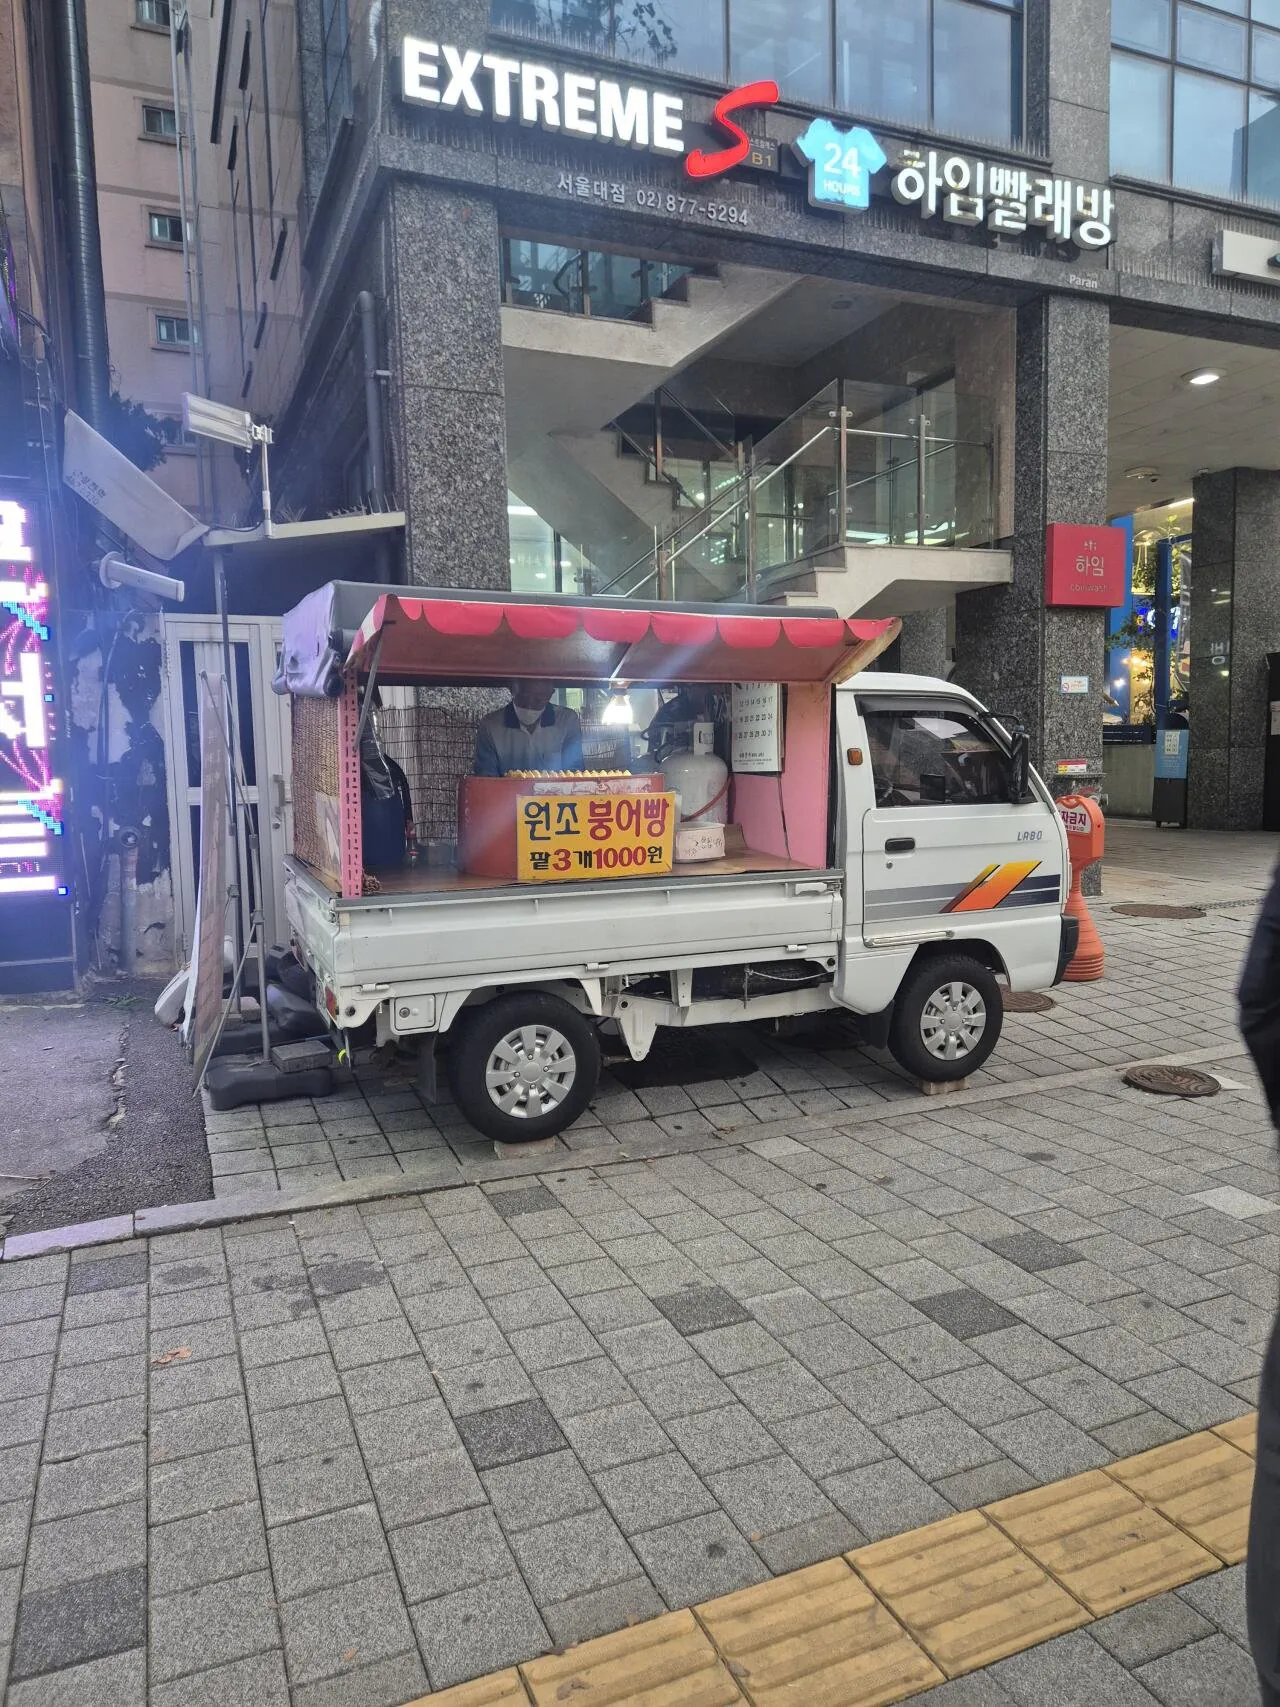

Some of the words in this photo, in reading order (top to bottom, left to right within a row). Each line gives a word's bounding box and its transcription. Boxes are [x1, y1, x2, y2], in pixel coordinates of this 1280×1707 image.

[403, 37, 685, 152] EXTREME
[685, 80, 779, 177] S
[752, 151, 772, 168] B1
[823, 142, 861, 179] 24
[558, 173, 626, 203] 서울대점
[666, 194, 748, 226] 877-5294
[823, 179, 861, 198] HOURS
[897, 149, 1115, 246] 하임빨래방
[1069, 274, 1098, 289] Paran
[1076, 555, 1104, 577] 하임
[524, 801, 581, 841] 원조
[587, 798, 670, 841] 붕어빵
[1017, 830, 1043, 841] LABO
